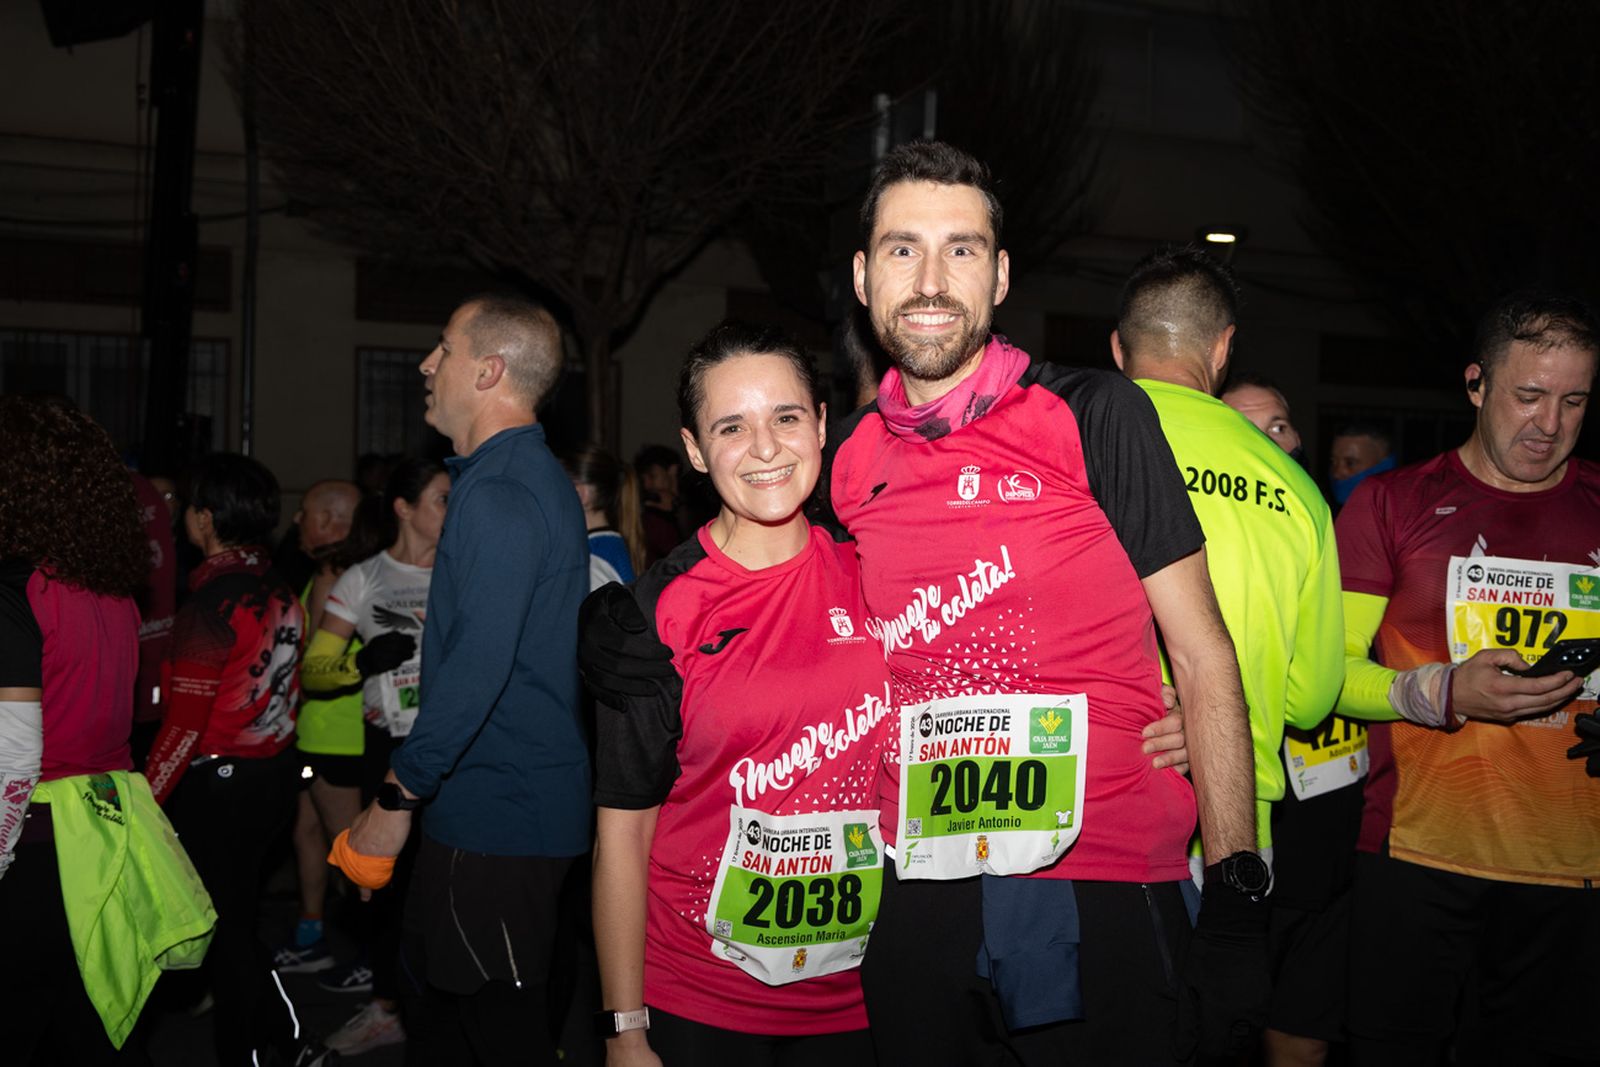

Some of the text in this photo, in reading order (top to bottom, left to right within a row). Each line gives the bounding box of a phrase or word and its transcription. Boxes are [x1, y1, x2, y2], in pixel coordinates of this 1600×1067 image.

[1186, 466, 1290, 516] 2008 F.S.
[941, 544, 1016, 626] coleta!
[1486, 572, 1554, 589] NOCHE DE
[1467, 587, 1555, 607] SAN ANTÓN
[1495, 606, 1568, 649] 972
[825, 681, 892, 760] coleta!
[934, 715, 1011, 736] NOCHE DE
[919, 732, 1011, 762] SAN ANTÓN
[930, 759, 1047, 817] 2040
[947, 815, 1021, 832] Javier Antonio
[761, 833, 832, 853] NOCHE DE
[742, 850, 833, 876] SAN ANTÓN
[742, 873, 862, 929] 2038
[756, 932, 812, 945] Ascension
